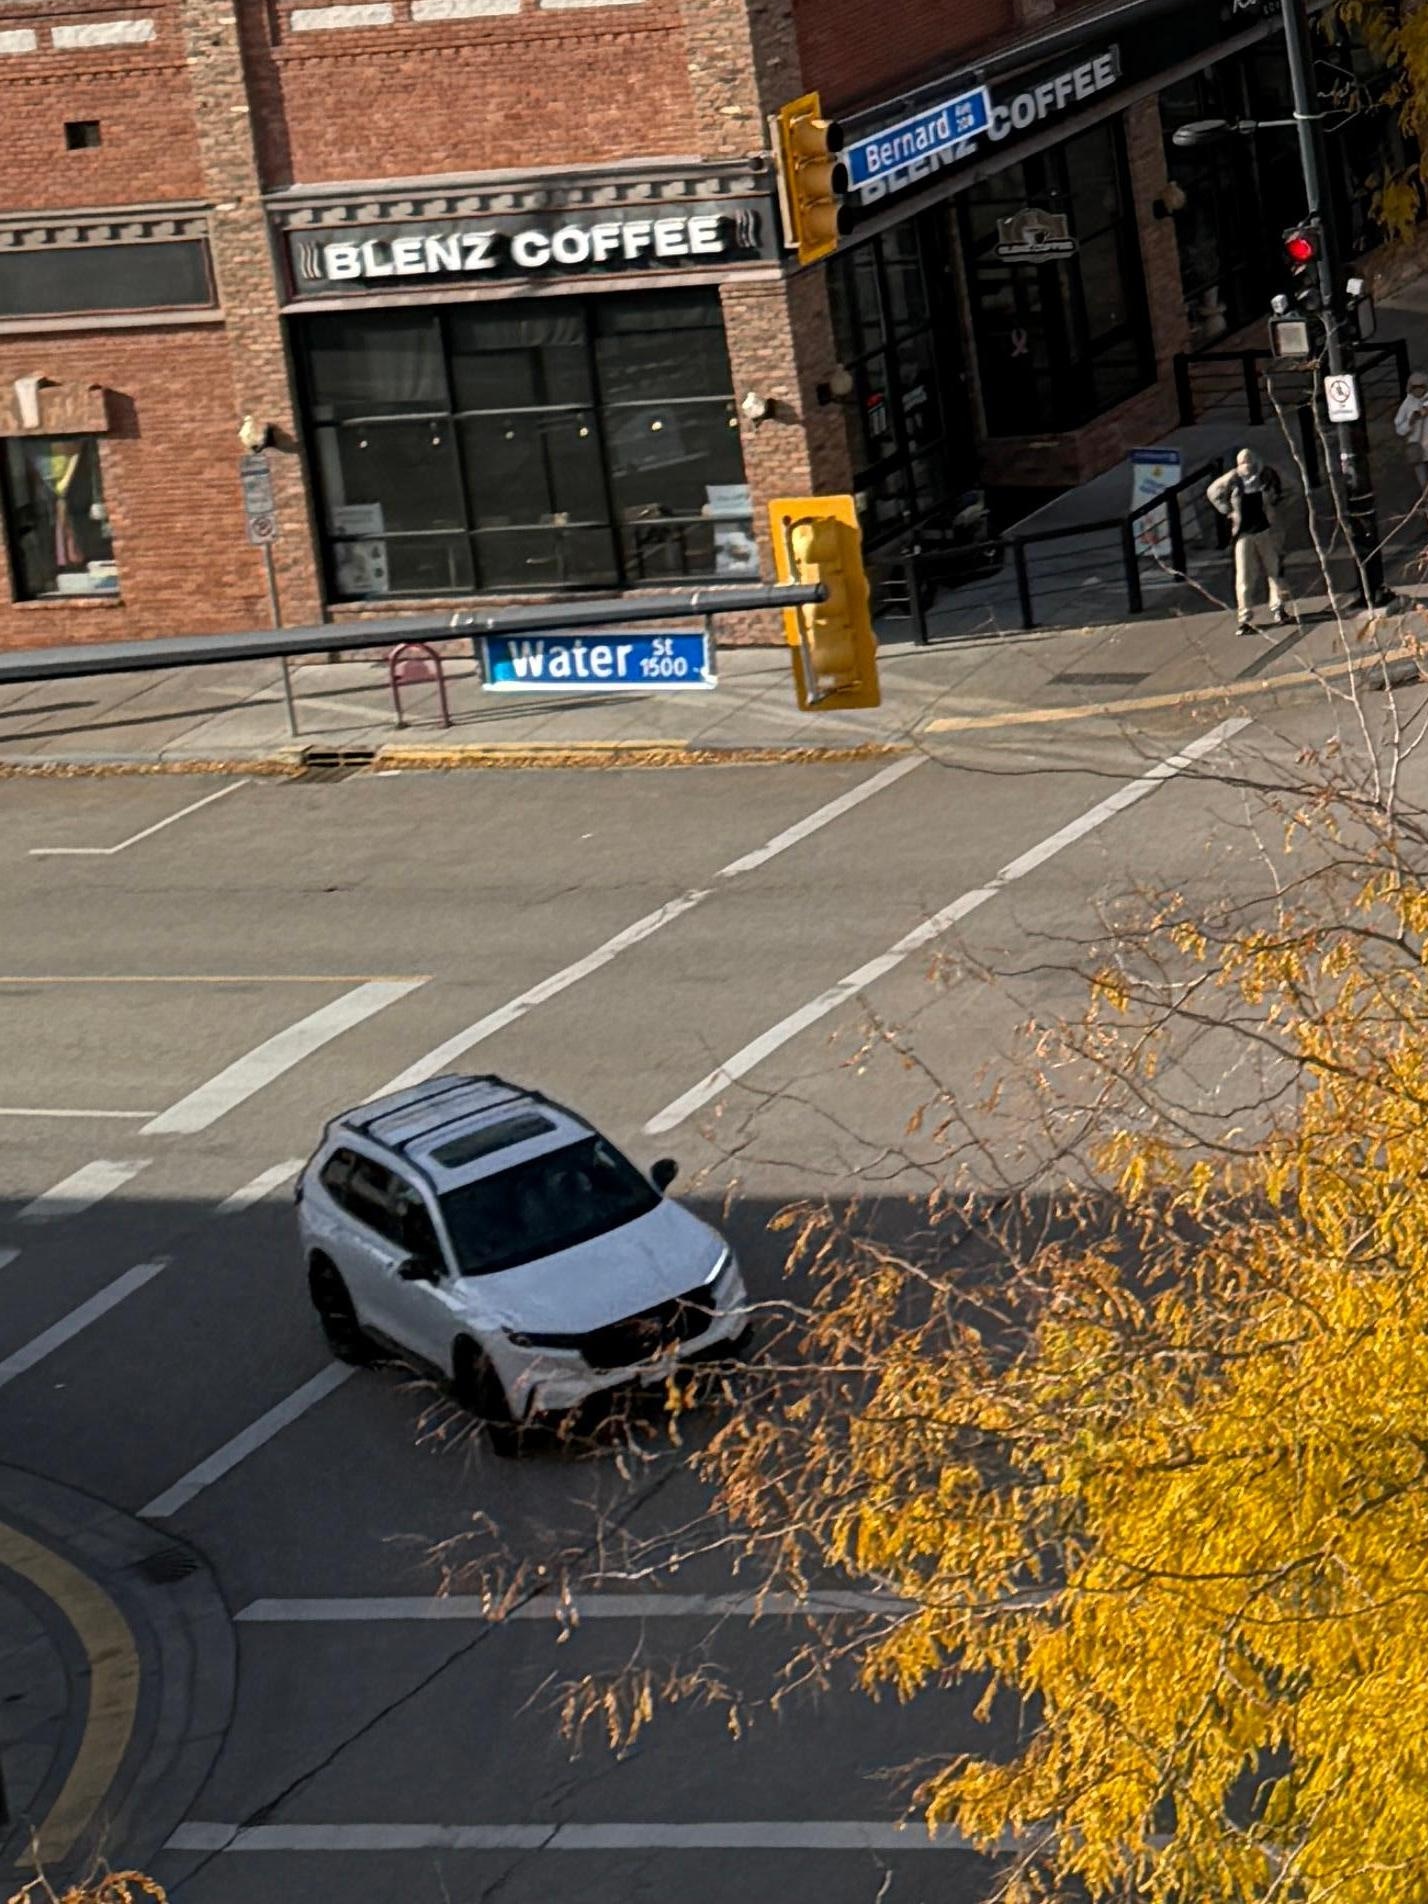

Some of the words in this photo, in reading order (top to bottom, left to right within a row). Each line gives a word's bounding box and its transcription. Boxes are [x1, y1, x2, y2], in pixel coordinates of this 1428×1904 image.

[986, 52, 1118, 142] COFFEE
[865, 111, 950, 173] Bernard
[324, 229, 499, 280] BLENZ
[511, 215, 724, 268] COFFEE
[508, 639, 633, 678] Water
[640, 656, 688, 678] 1500
[652, 638, 674, 656] St
